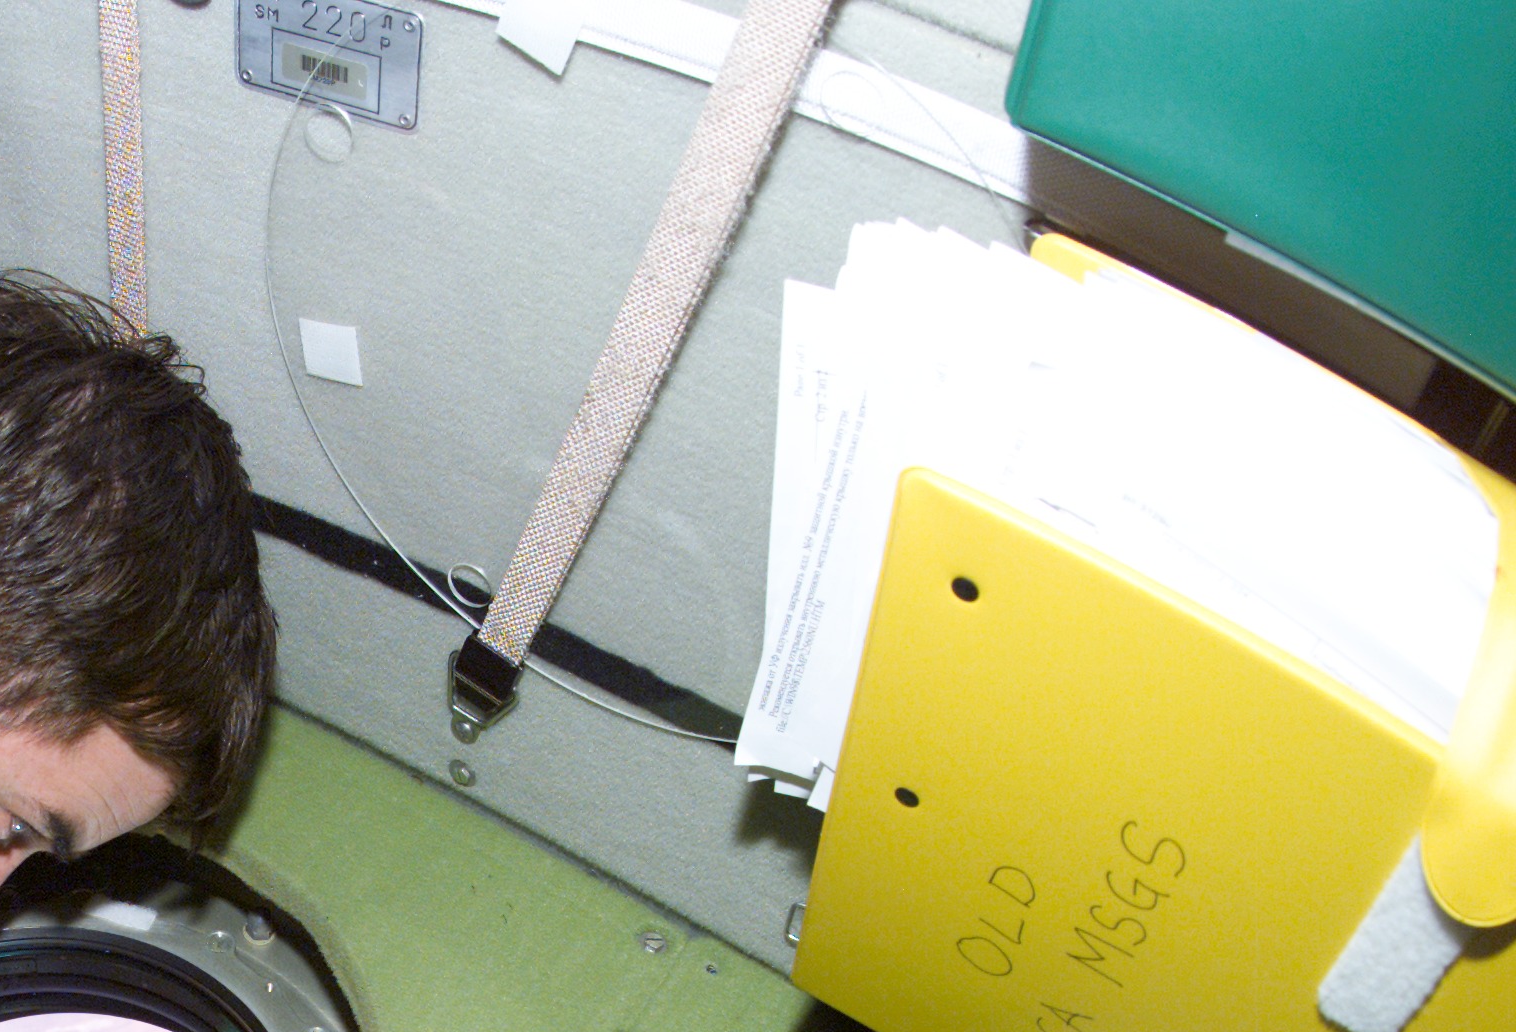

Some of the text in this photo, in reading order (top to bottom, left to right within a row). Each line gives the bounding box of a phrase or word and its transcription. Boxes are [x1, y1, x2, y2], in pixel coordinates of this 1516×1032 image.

[254, 3, 280, 23] SM
[301, 0, 366, 43] 220
[956, 865, 1036, 977] OLD
[1066, 820, 1186, 988] MSGS
